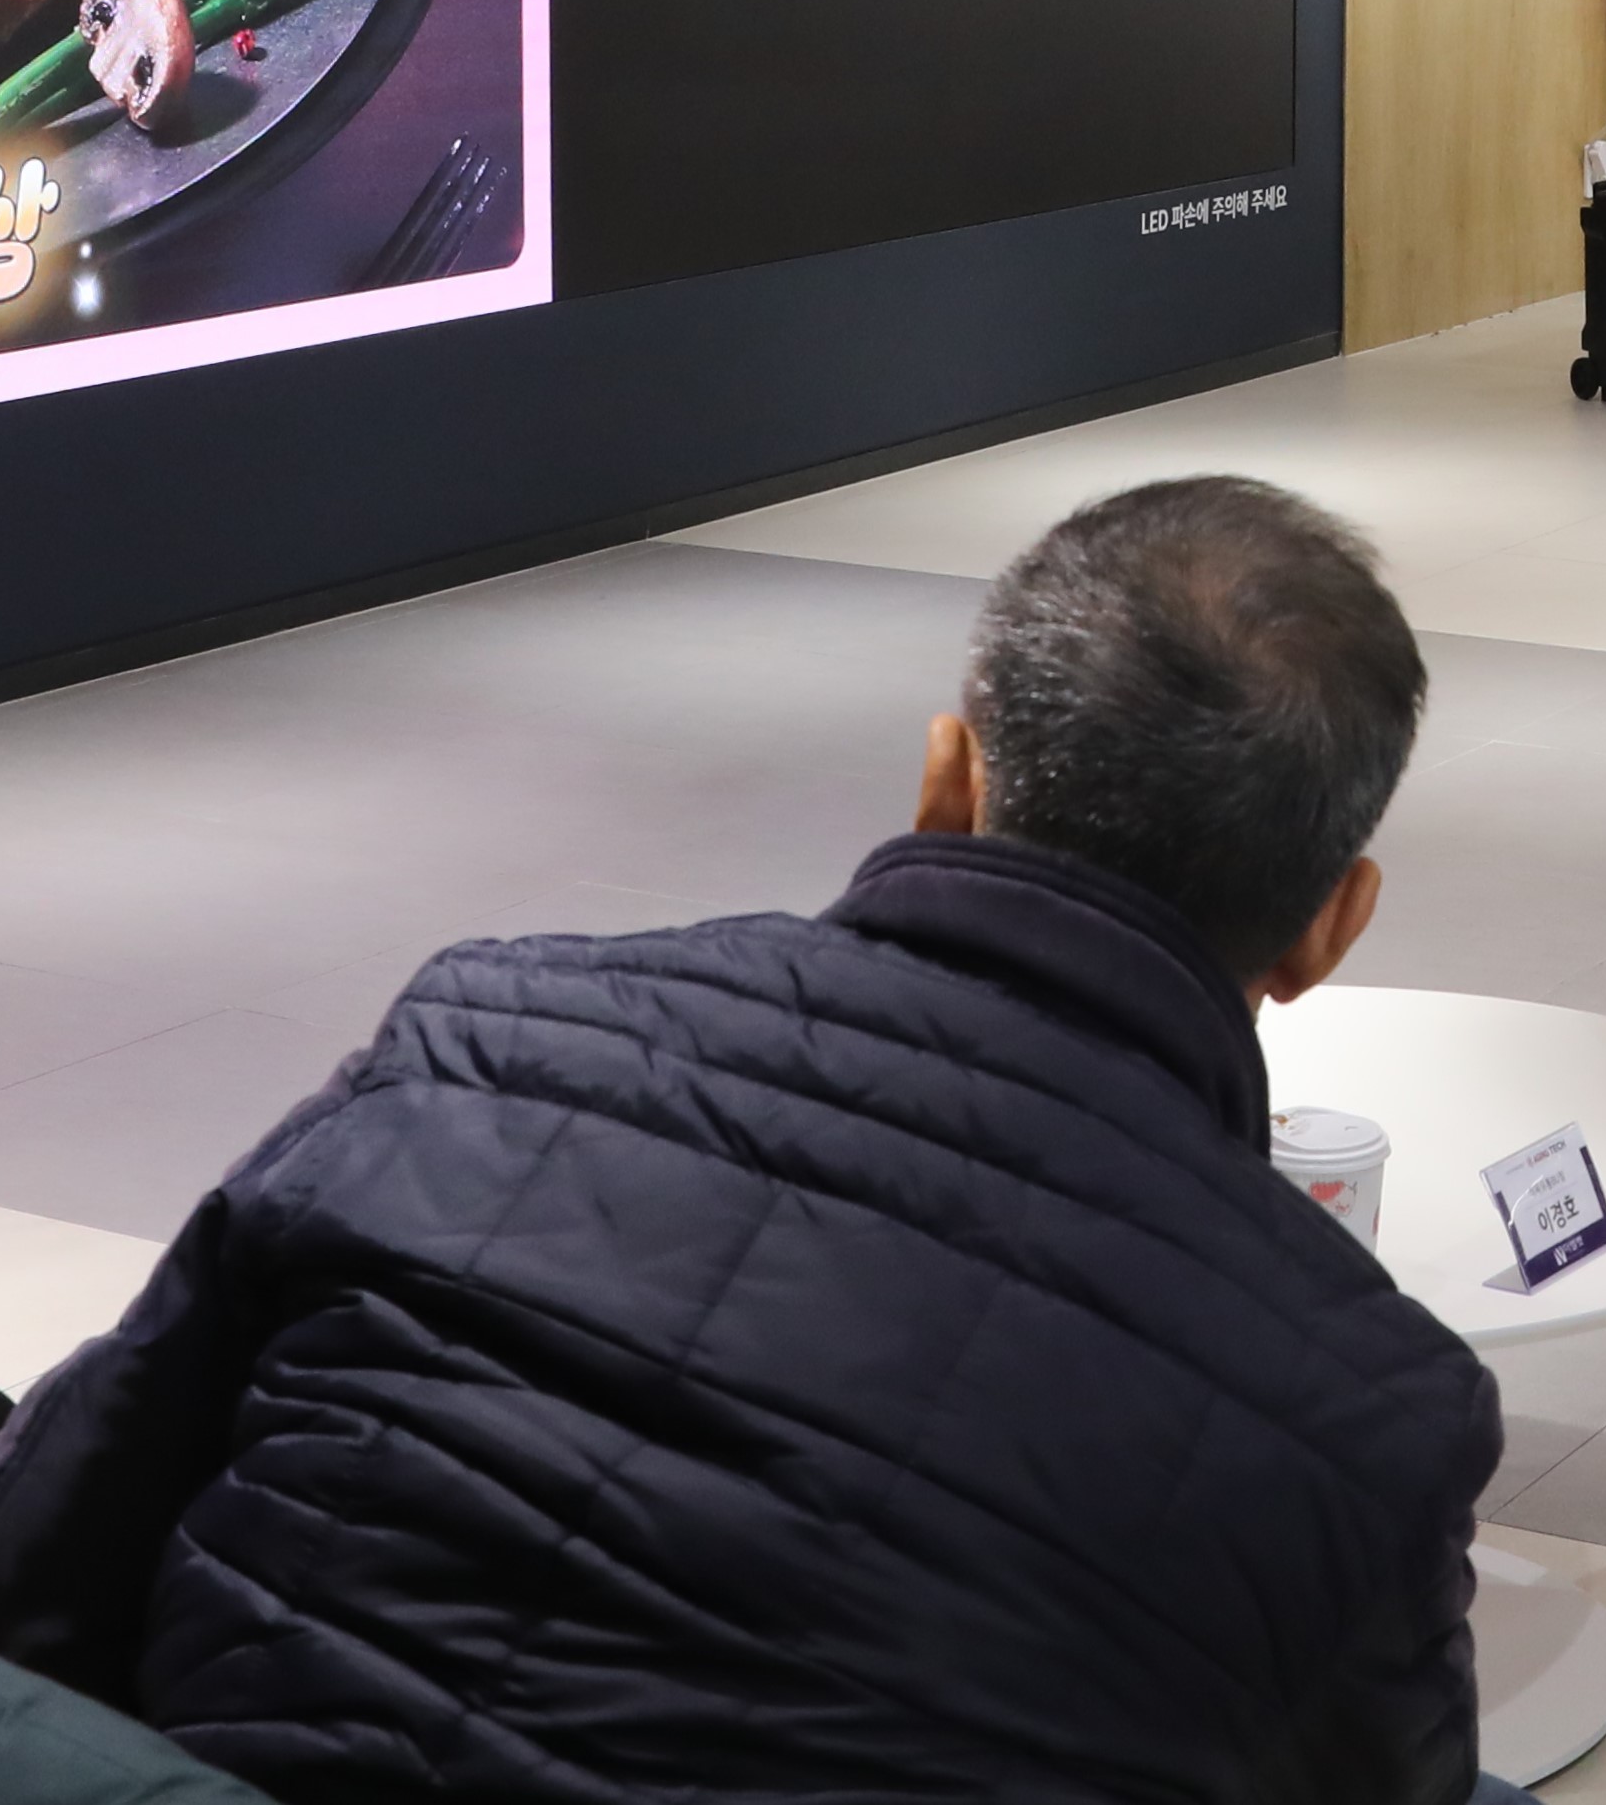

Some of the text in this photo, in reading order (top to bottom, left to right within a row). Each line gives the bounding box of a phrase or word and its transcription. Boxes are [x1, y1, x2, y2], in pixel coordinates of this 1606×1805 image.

[1141, 184, 1288, 235] LED 파손에 주의해 주세요
[1538, 1195, 1580, 1233] 이경호
